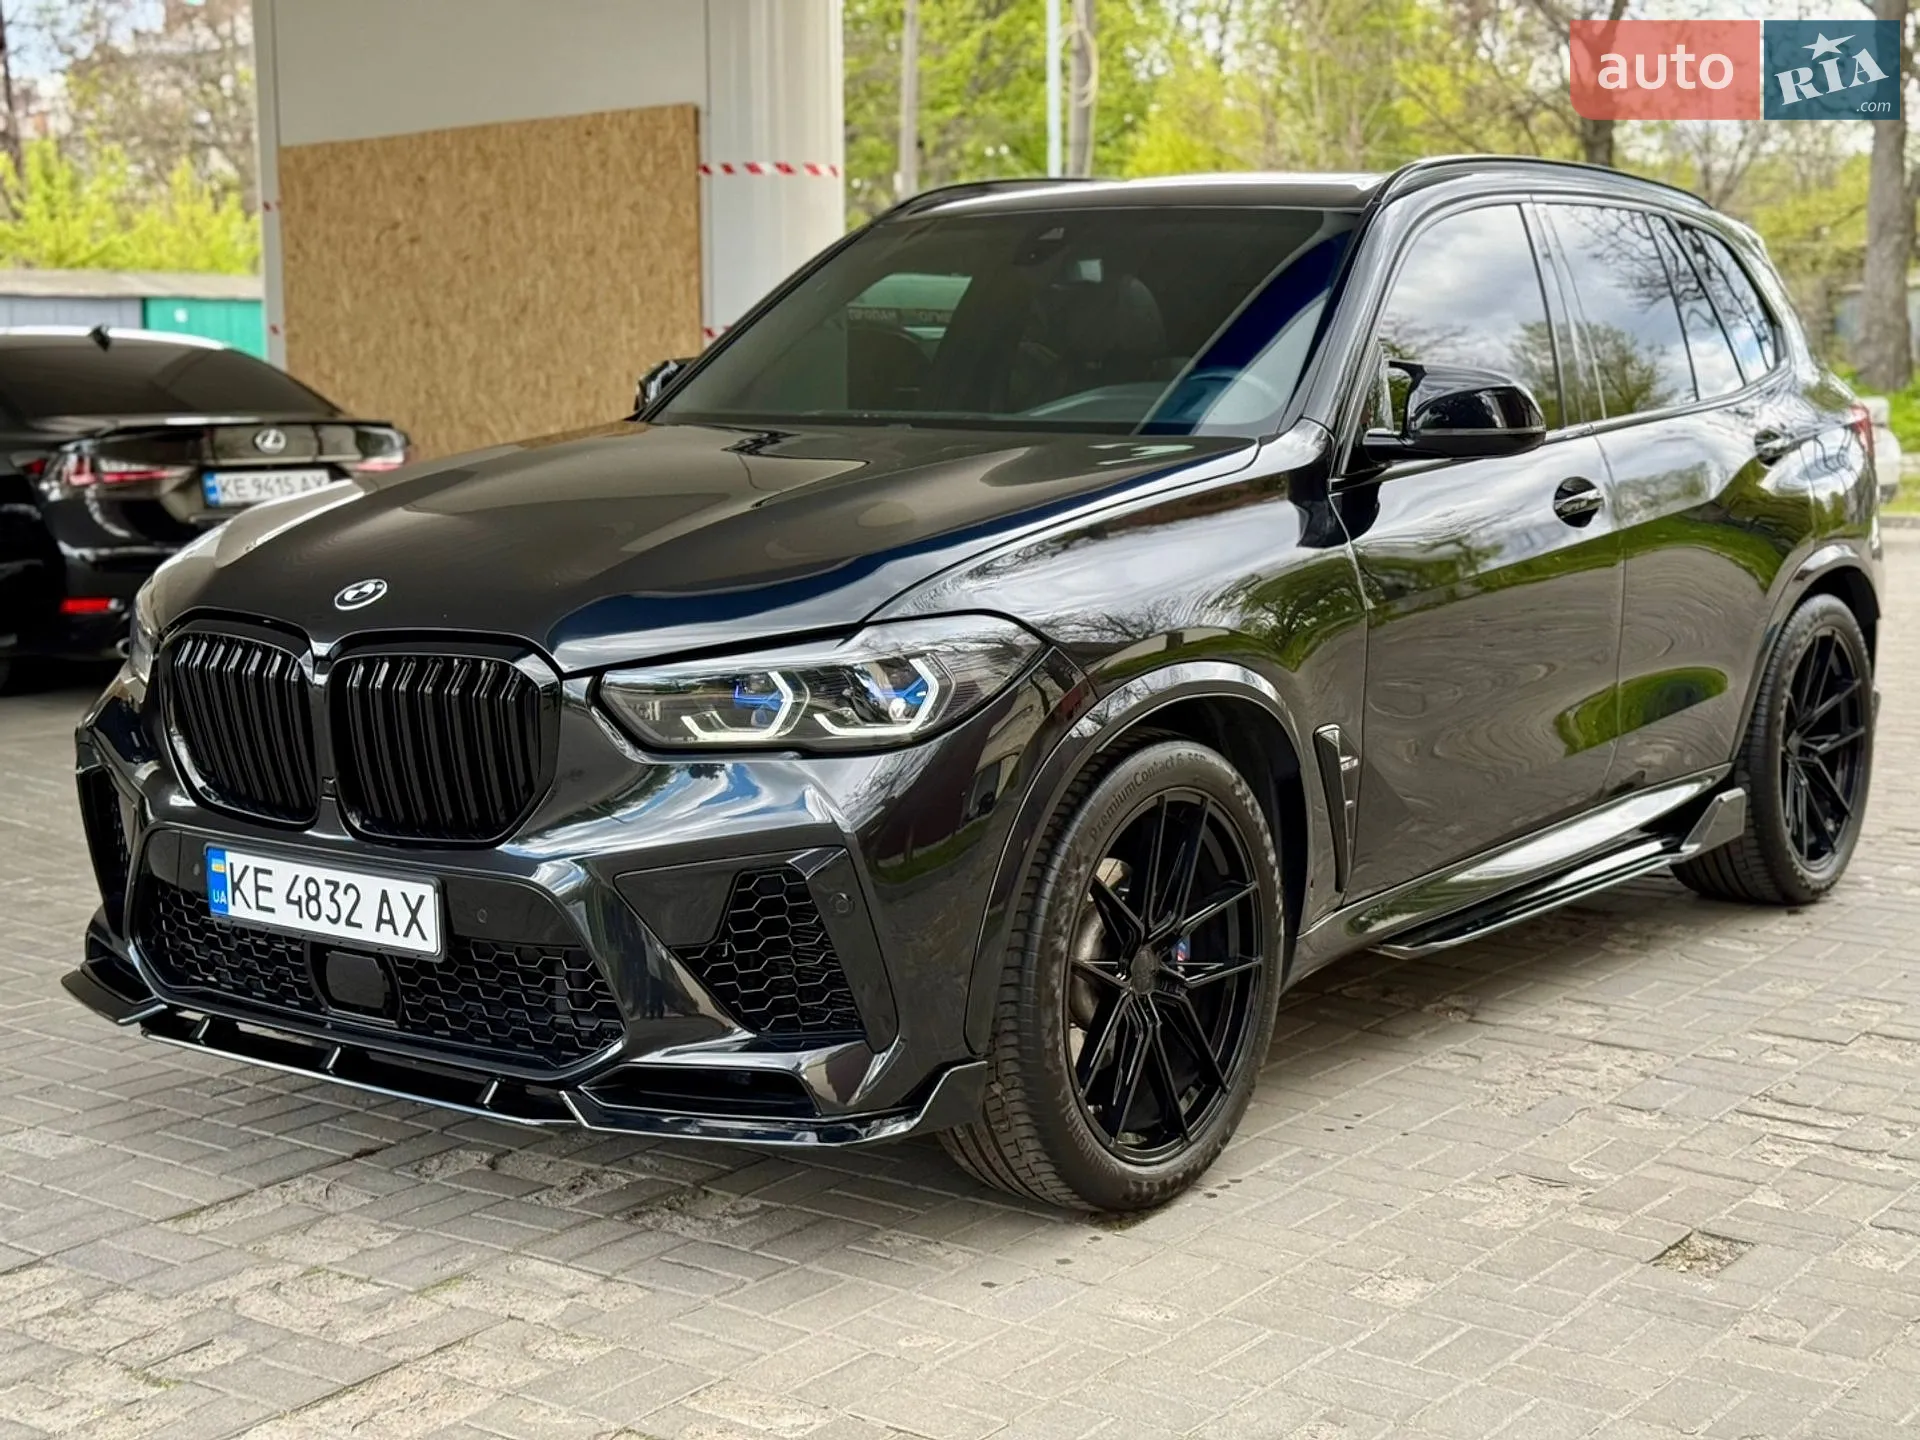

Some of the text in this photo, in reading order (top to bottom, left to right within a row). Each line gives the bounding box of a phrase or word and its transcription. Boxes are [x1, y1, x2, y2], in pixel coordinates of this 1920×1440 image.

[220, 479, 247, 500] KE
[213, 889, 227, 905] UA
[229, 862, 427, 941] KE 4832 AX
